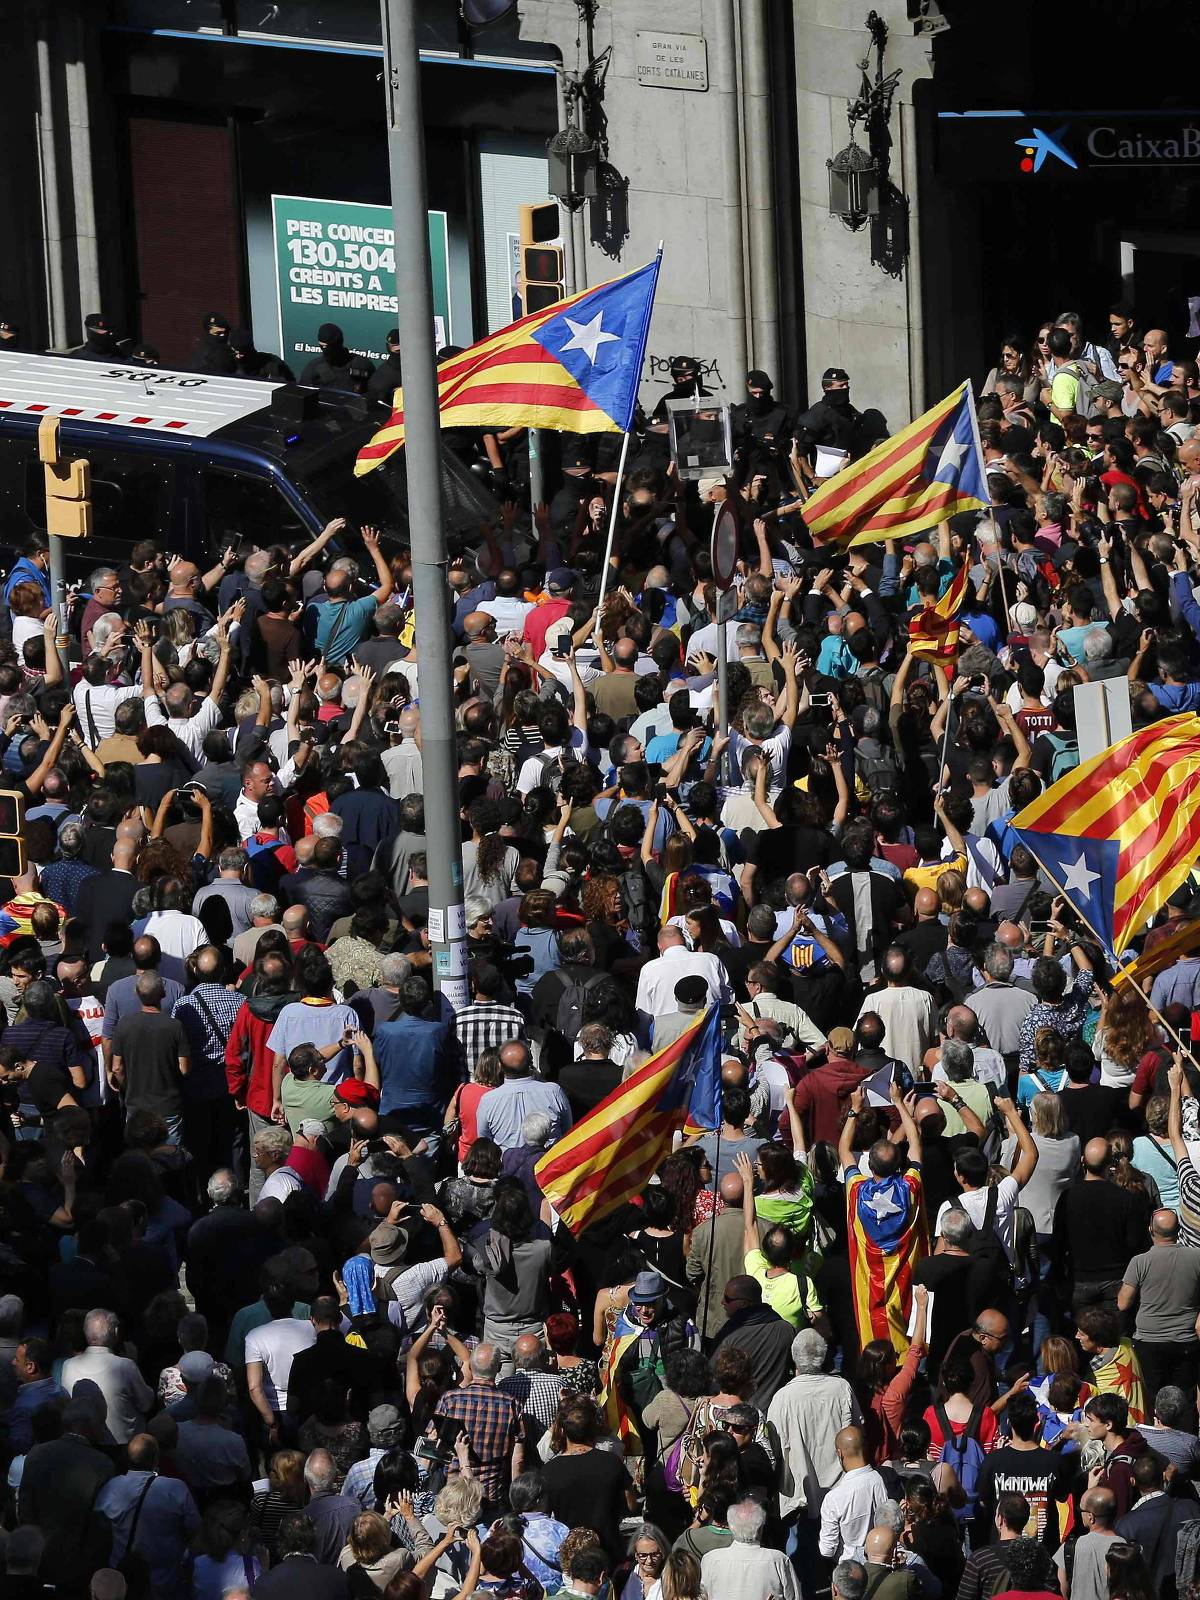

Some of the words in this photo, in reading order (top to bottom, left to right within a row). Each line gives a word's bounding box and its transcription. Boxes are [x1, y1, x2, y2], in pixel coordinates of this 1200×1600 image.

[637, 65, 661, 77] CORTS
[665, 67, 705, 81] CATALANES
[286, 219, 323, 239] PER
[327, 223, 395, 246] CONCED
[287, 238, 396, 273] 130.504
[289, 264, 364, 289] CRÈDITS
[367, 275, 383, 291] A
[290, 286, 324, 305] LES
[327, 290, 399, 313] EMPRES
[294, 342, 304, 352] El
[305, 343, 324, 353] ban
[367, 350, 380, 360] les
[1024, 715, 1052, 727] TOTTI
